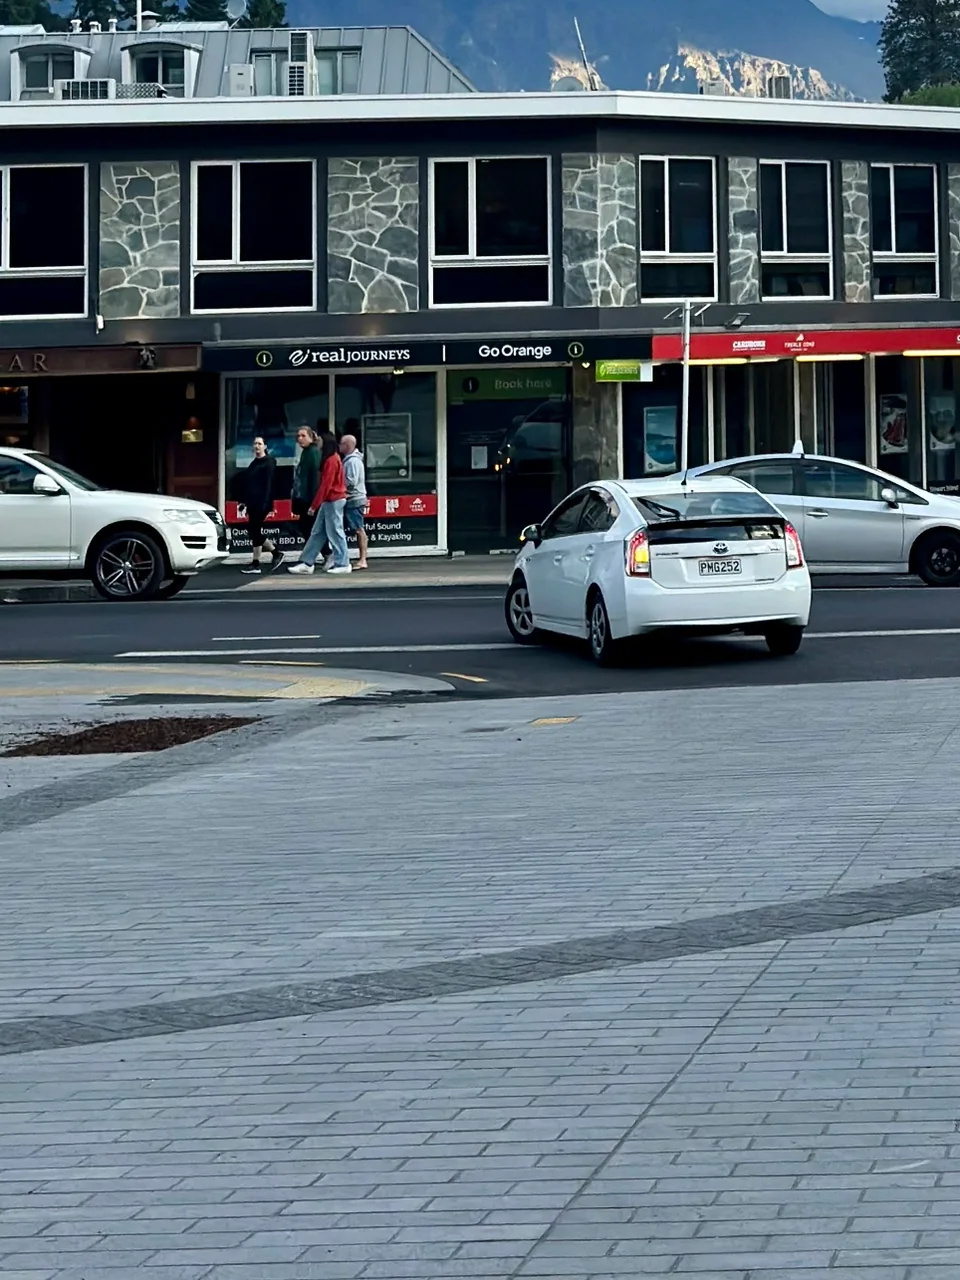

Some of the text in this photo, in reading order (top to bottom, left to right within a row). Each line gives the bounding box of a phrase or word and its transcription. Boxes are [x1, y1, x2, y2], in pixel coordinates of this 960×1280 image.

[478, 344, 552, 359] Go Orange
[0, 352, 49, 371] AR
[495, 379, 523, 389] Book
[377, 522, 402, 530] Sound
[279, 536, 296, 545] BBQ
[370, 533, 376, 541] &
[378, 532, 412, 542] Kayaking
[700, 560, 740, 573] PMG252
